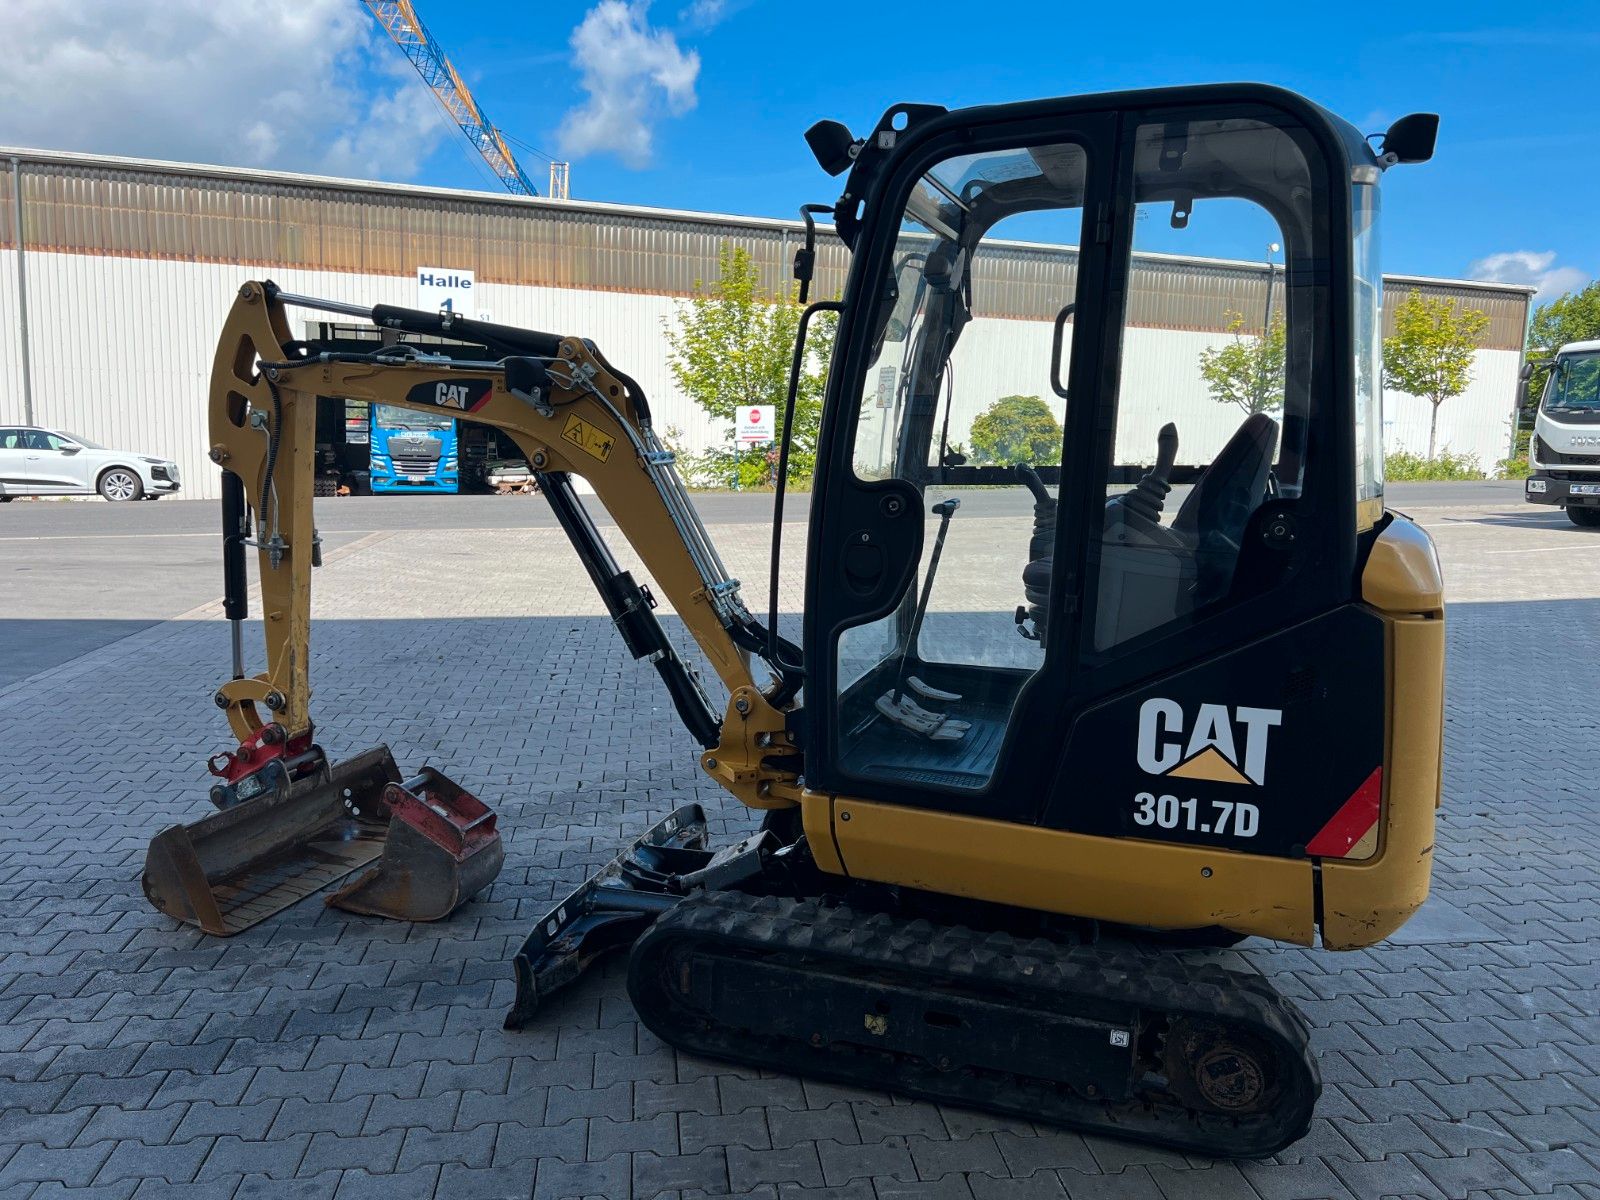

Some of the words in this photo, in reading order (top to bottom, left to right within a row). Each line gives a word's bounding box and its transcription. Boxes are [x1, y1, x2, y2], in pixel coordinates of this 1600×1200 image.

[420, 273, 472, 289] Halle
[440, 298, 453, 312] 1
[435, 382, 469, 409] CAT
[1137, 697, 1283, 786] CAT
[1133, 792, 1260, 837] 301.7D
